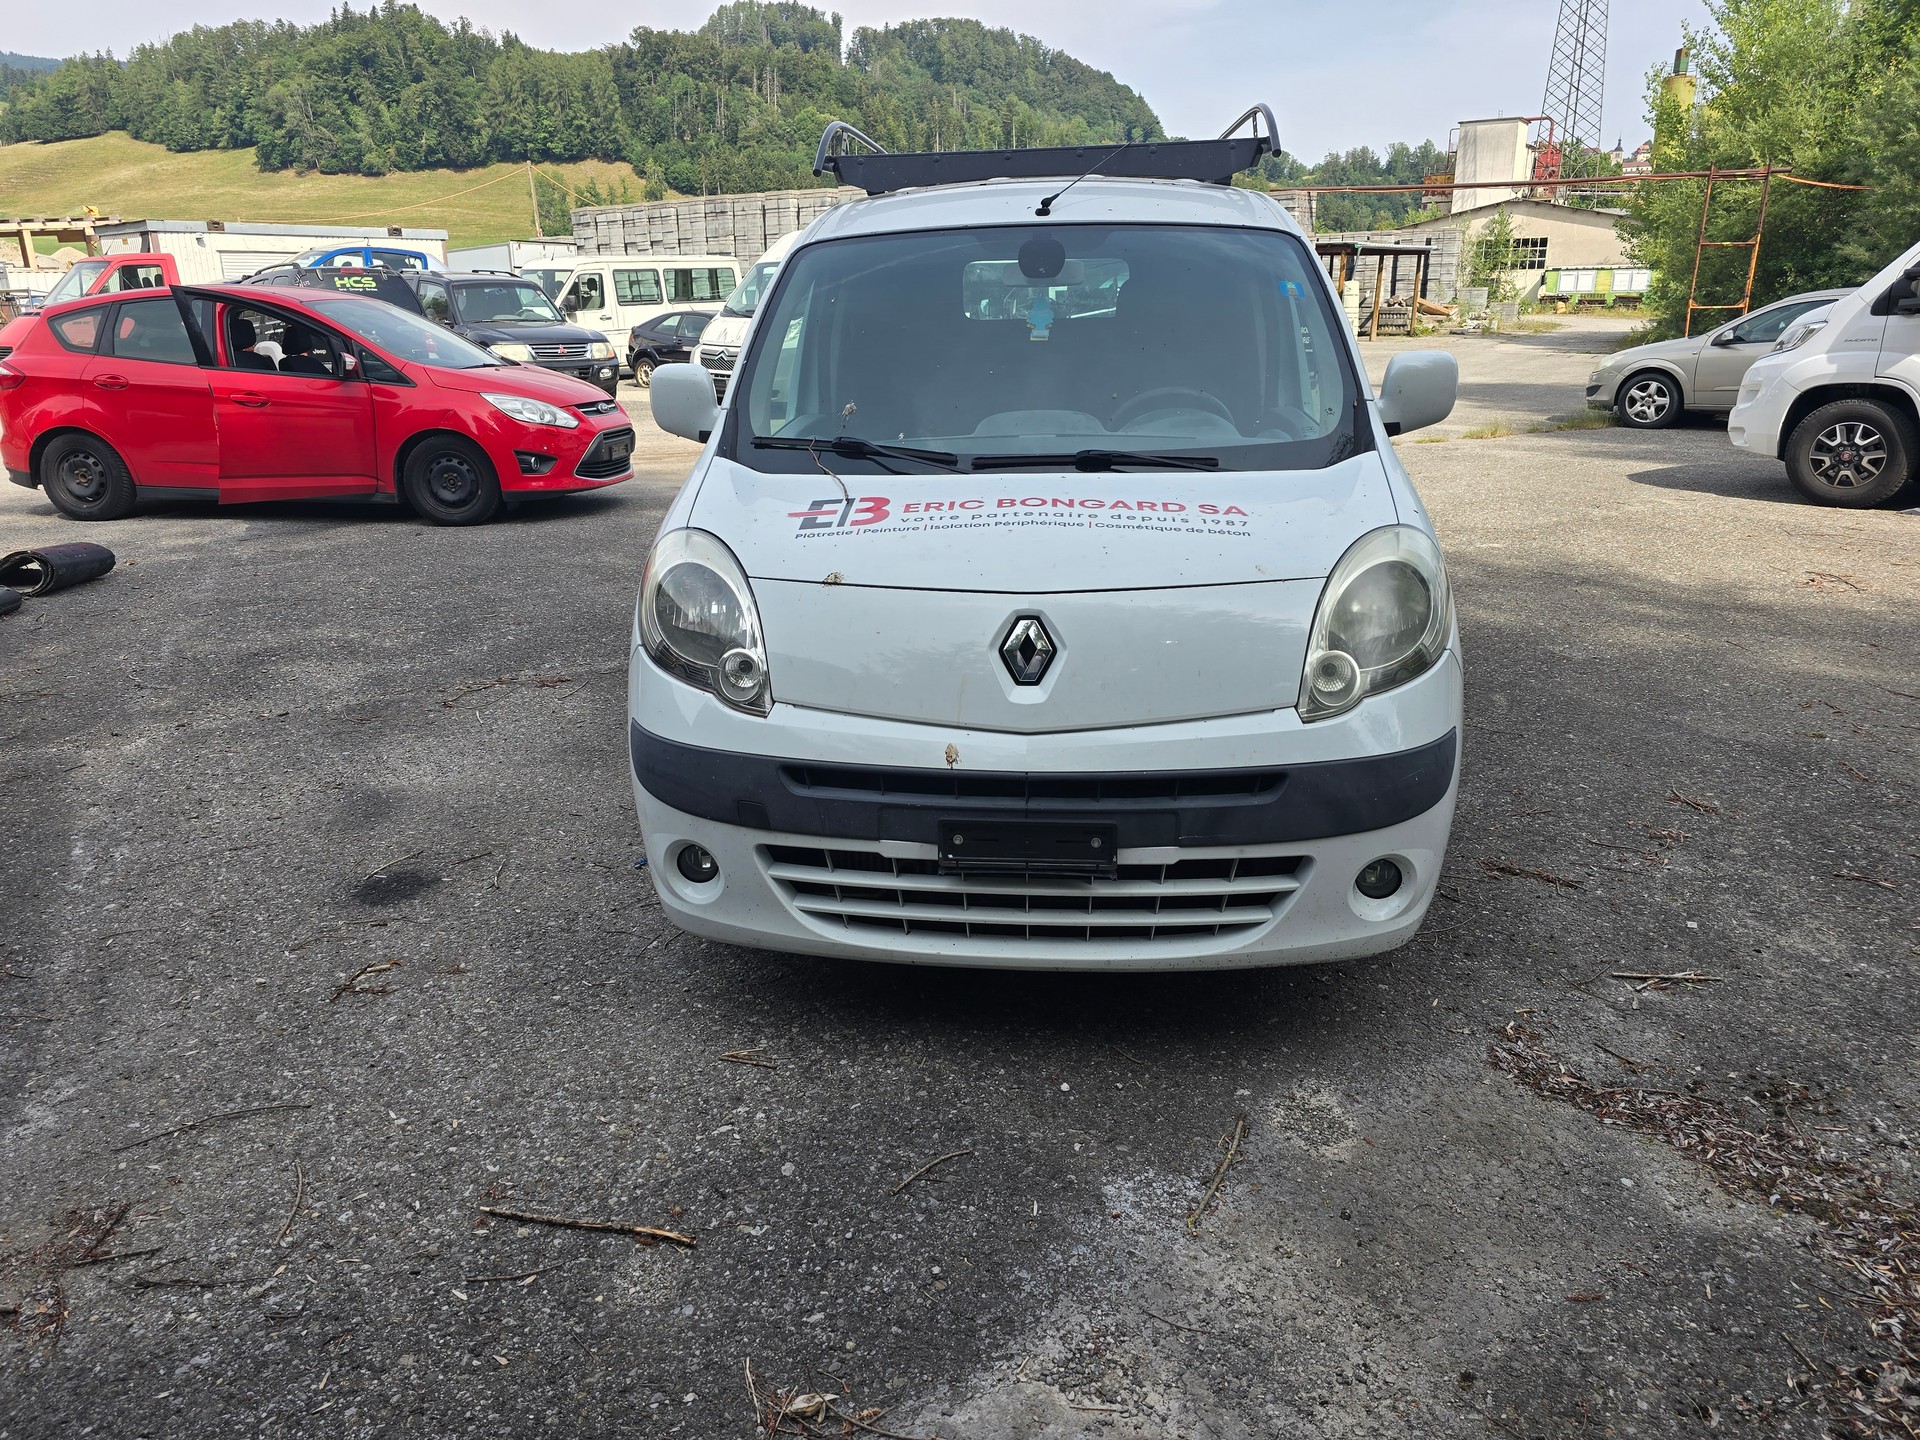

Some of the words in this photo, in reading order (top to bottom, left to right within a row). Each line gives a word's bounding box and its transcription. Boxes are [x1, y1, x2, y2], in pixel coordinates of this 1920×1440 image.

[334, 276, 377, 288] HCS
[903, 499, 985, 514] ERIC
[996, 497, 1187, 513] BONGARD
[1197, 503, 1249, 517] SA
[901, 514, 960, 523] votre
[971, 509, 1099, 520] partenaire
[1110, 512, 1190, 523] depuis
[1201, 518, 1249, 527] 1987
[863, 525, 920, 535] Peinture
[930, 521, 991, 531] Isolation
[994, 519, 1085, 528] Périphérique
[1094, 521, 1182, 533] Cosmétique
[1185, 526, 1205, 534] de
[1207, 528, 1252, 537] béton
